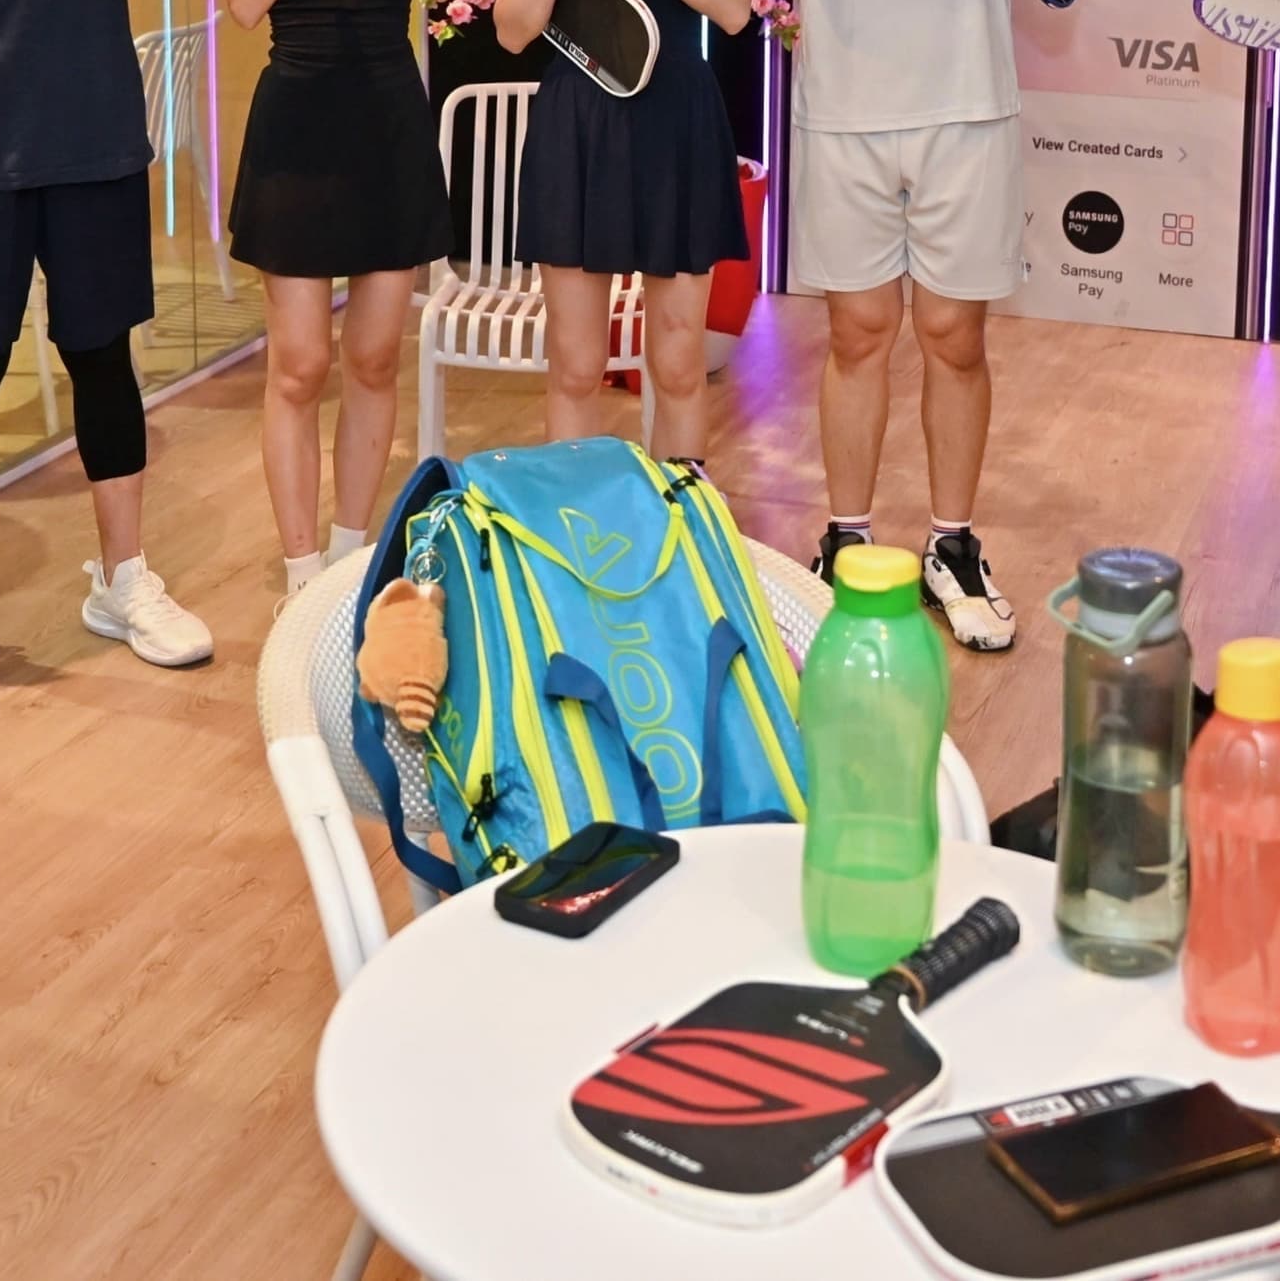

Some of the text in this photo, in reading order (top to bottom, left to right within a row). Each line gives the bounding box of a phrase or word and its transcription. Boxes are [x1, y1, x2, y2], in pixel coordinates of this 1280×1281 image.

[1106, 37, 1200, 73] VISA
[1145, 74, 1200, 88] Platinum
[1032, 137, 1163, 159] View Created Cards
[1068, 210, 1119, 223] SAMSUNG
[1068, 222, 1089, 236] Pay
[1060, 262, 1123, 284] Samsung
[1159, 272, 1194, 288] More
[1078, 282, 1104, 299] Pay
